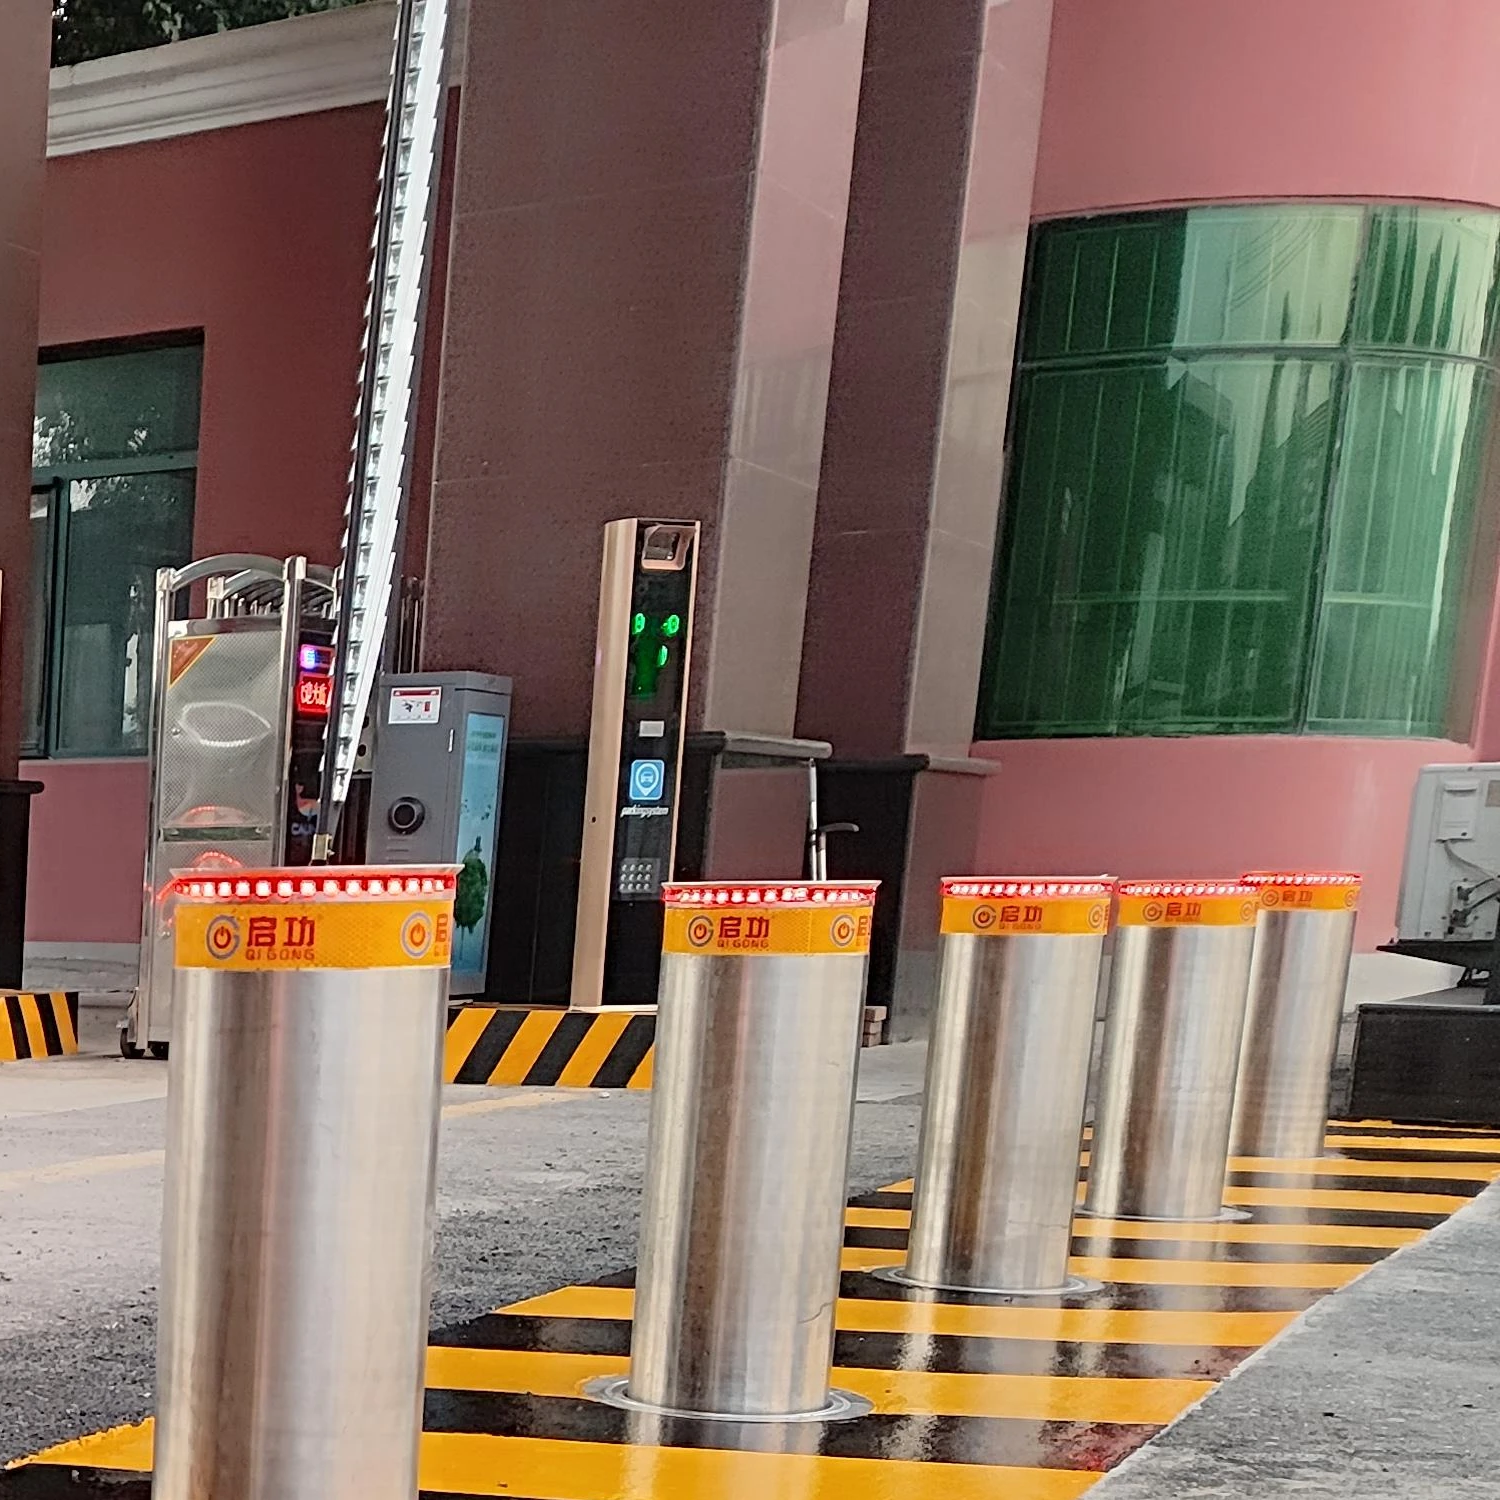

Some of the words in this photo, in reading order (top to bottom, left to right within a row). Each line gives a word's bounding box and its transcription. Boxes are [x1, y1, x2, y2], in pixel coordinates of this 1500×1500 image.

[1000, 905, 1043, 922] 启功
[246, 915, 316, 948] 启功
[719, 915, 770, 938] 启功
[857, 915, 871, 936] 启
